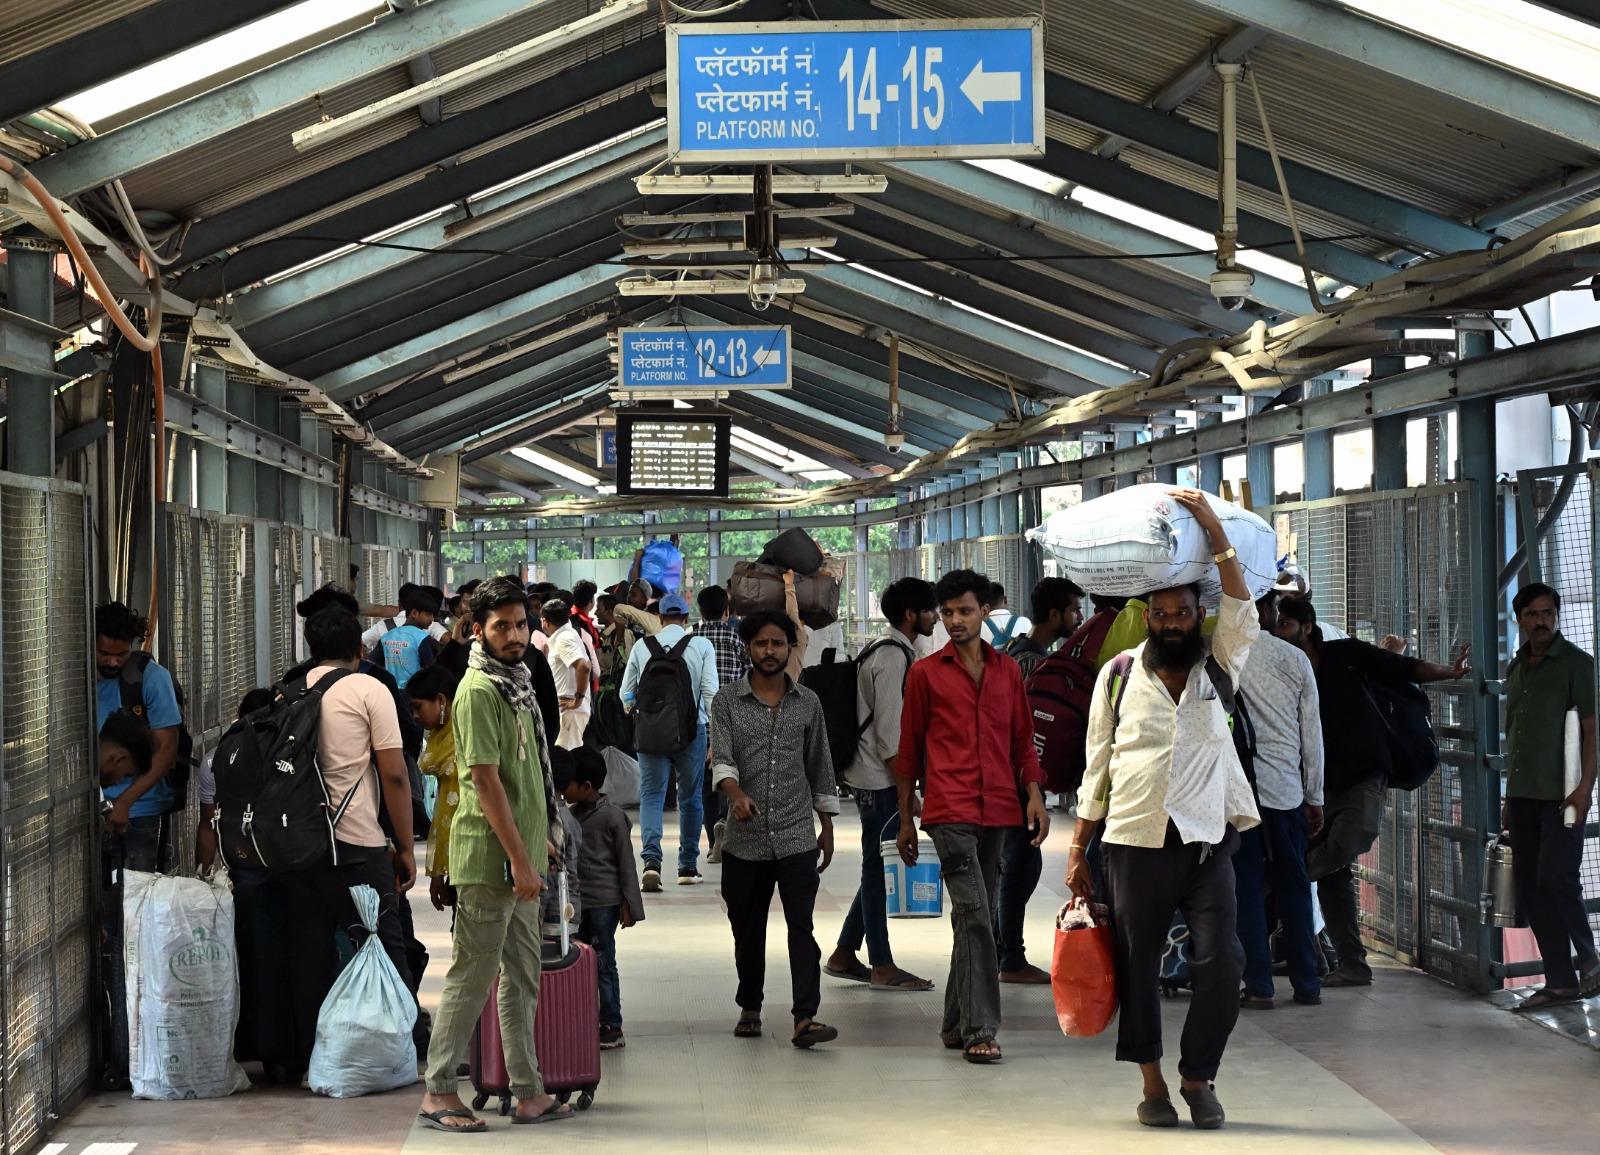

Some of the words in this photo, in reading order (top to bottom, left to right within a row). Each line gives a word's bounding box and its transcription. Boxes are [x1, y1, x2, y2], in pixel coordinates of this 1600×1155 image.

[695, 47, 788, 76] प्लॅटफॉर्म
[794, 48, 819, 75] नं.
[695, 82, 788, 112] प्लेटफार्म
[794, 83, 819, 111] नं.
[839, 46, 945, 132] 14-15
[696, 119, 786, 140] PLATFORM
[791, 119, 819, 138] NO.
[630, 338, 674, 352] प्लॅटफॉर्म
[676, 339, 688, 352] नं.
[695, 337, 748, 378] 12-13
[630, 354, 674, 369] प्लेटफार्म
[676, 355, 688, 368] नं.
[631, 371, 673, 381] PLATFORM
[674, 371, 689, 381] NO.
